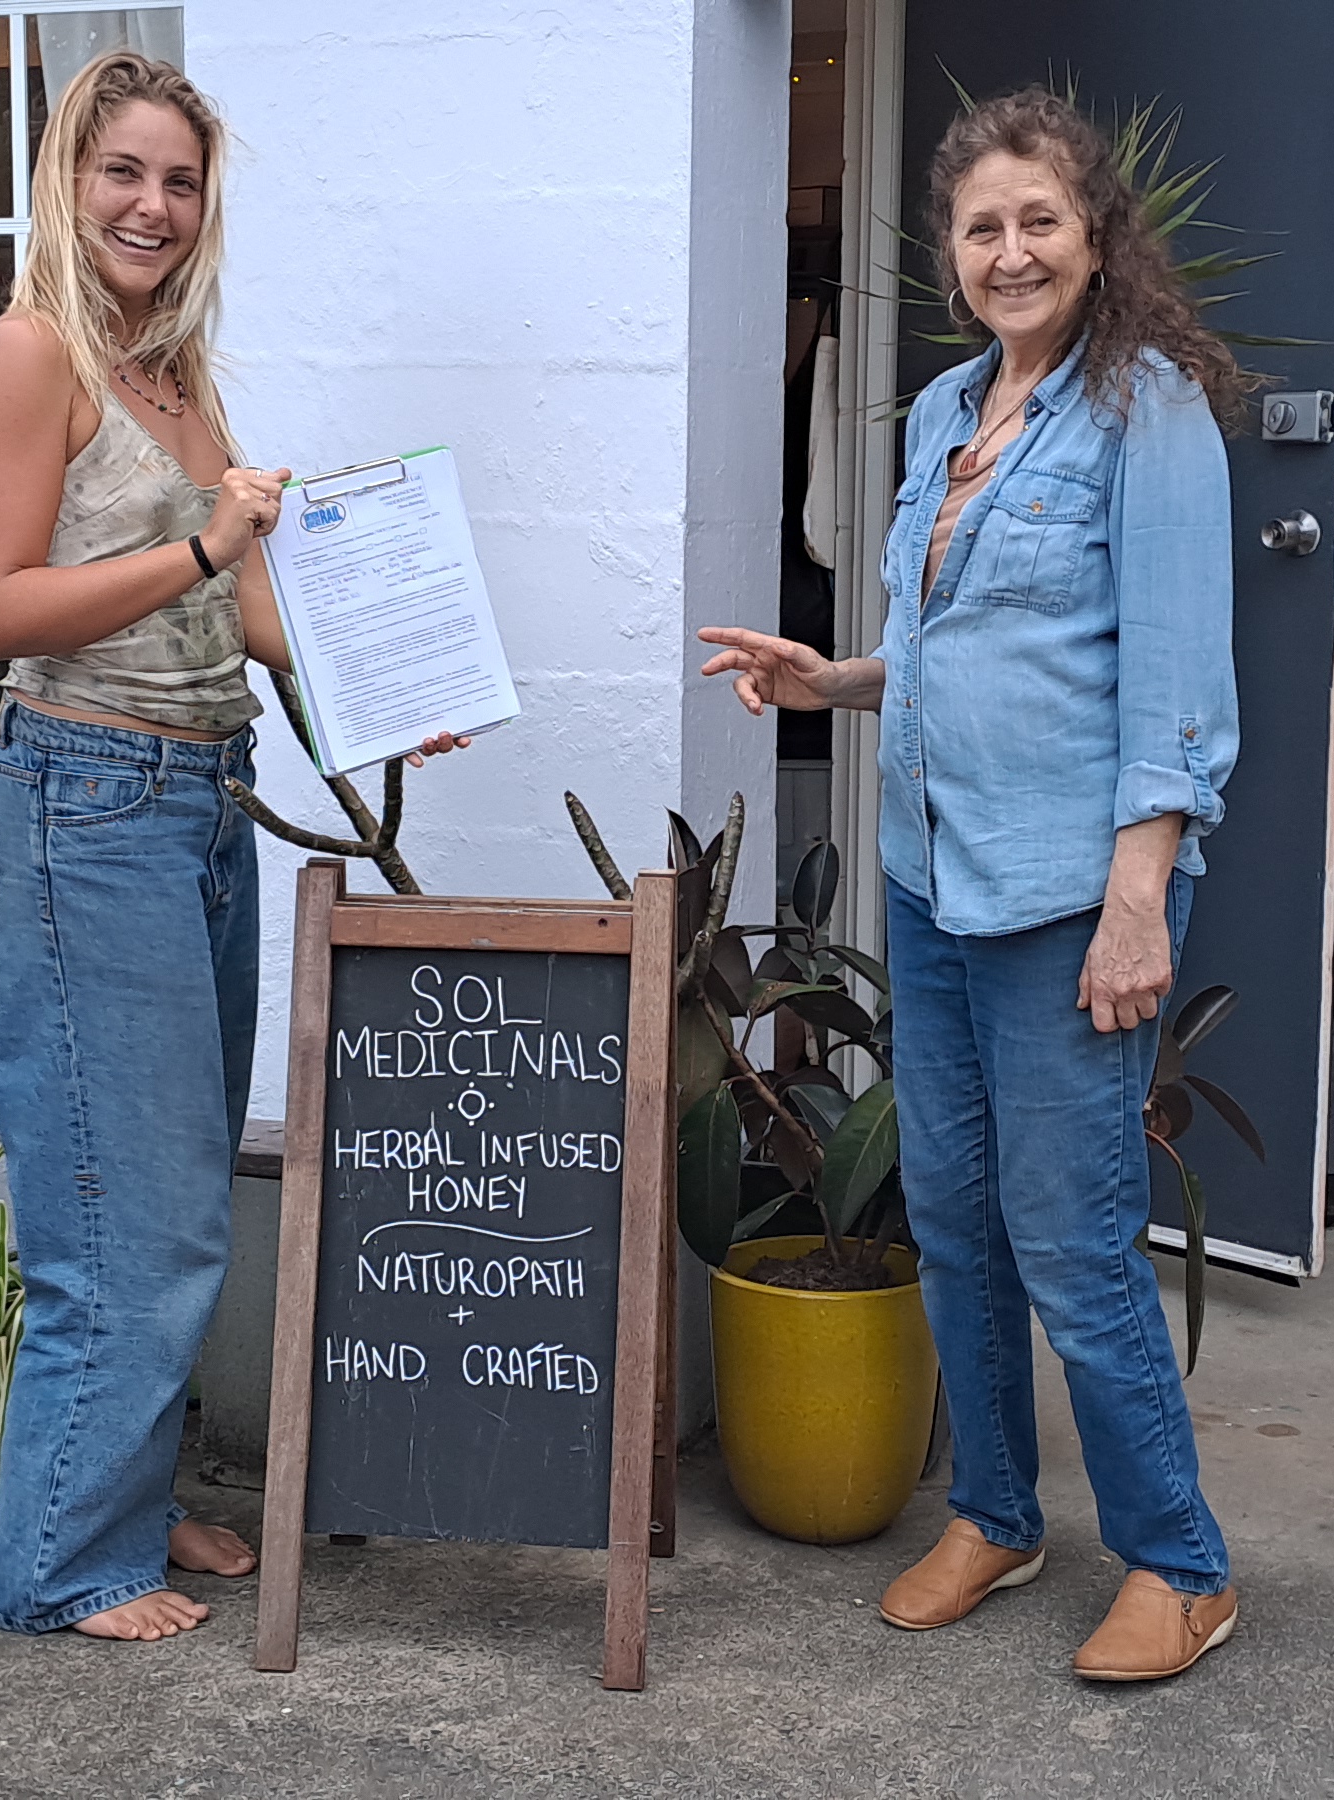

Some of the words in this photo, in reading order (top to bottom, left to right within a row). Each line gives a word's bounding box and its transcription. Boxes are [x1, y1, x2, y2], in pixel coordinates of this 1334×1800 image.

[318, 505, 344, 525] RAIL
[411, 965, 543, 1027] SOL
[336, 1026, 621, 1085] MEDICINALS
[335, 1128, 465, 1170] HERBAL
[481, 1131, 622, 1173] INFUSED
[408, 1174, 527, 1219] HONEY
[358, 1251, 585, 1299] NATUROPATH
[326, 1336, 426, 1383] HAND
[462, 1342, 599, 1395] CRAFTED
